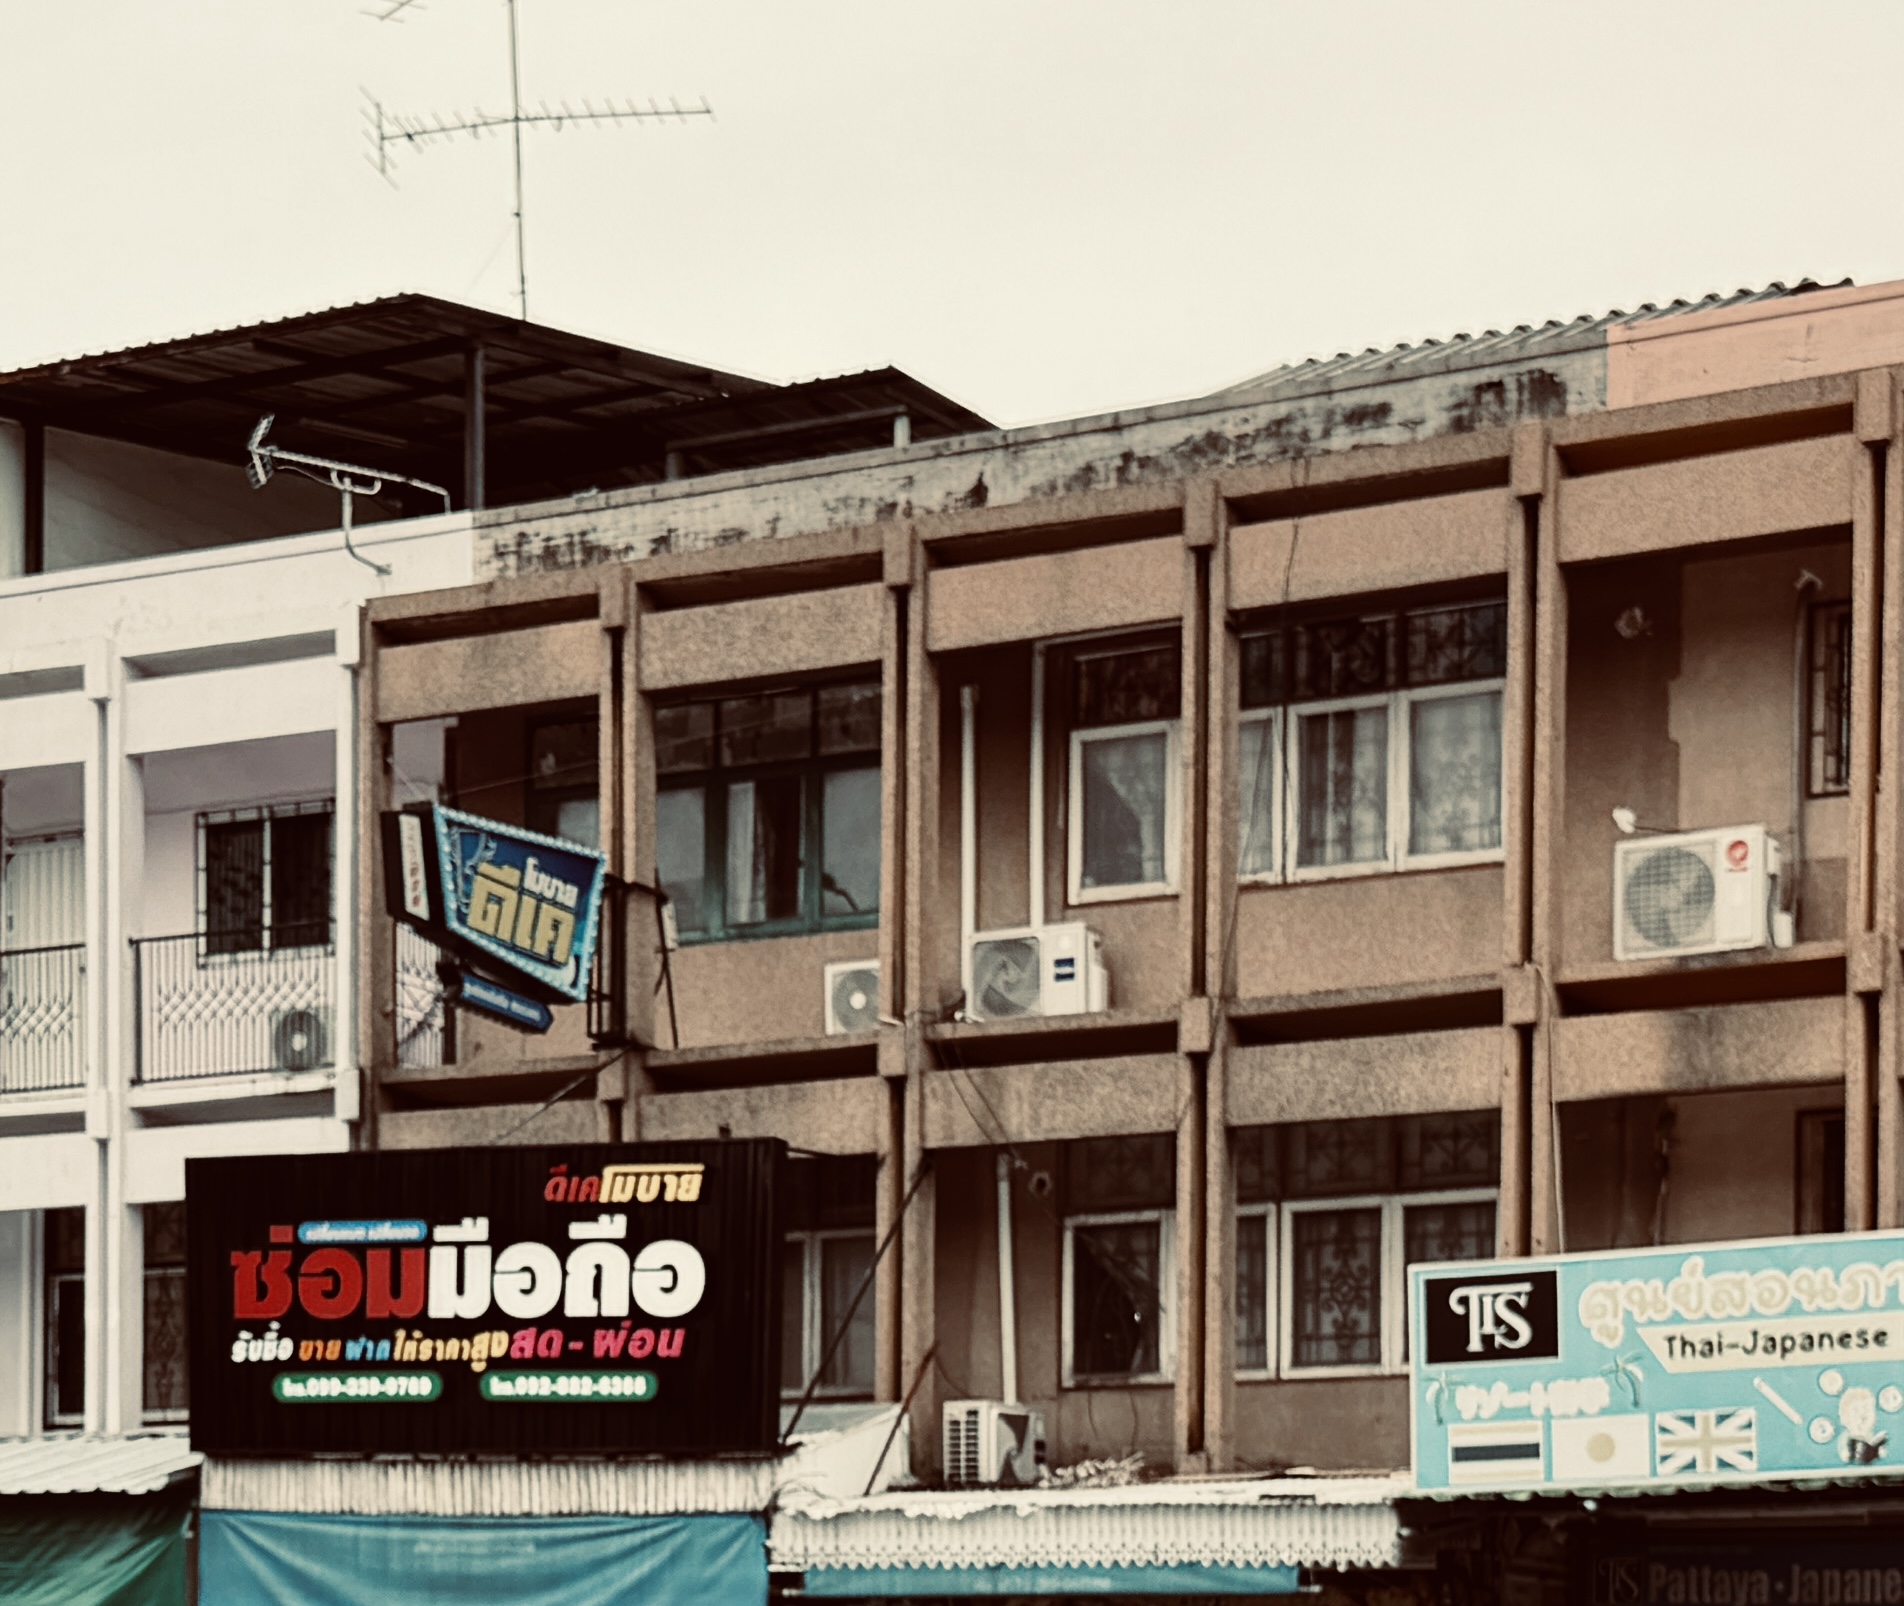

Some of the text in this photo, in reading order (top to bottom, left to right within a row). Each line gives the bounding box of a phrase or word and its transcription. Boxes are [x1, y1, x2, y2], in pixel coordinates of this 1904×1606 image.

[231, 1321, 294, 1363] รับซื้อ
[298, 1338, 342, 1361] ขาย
[592, 1320, 686, 1360] ผ่อน
[1663, 1328, 1889, 1361] Thai-Japanese
